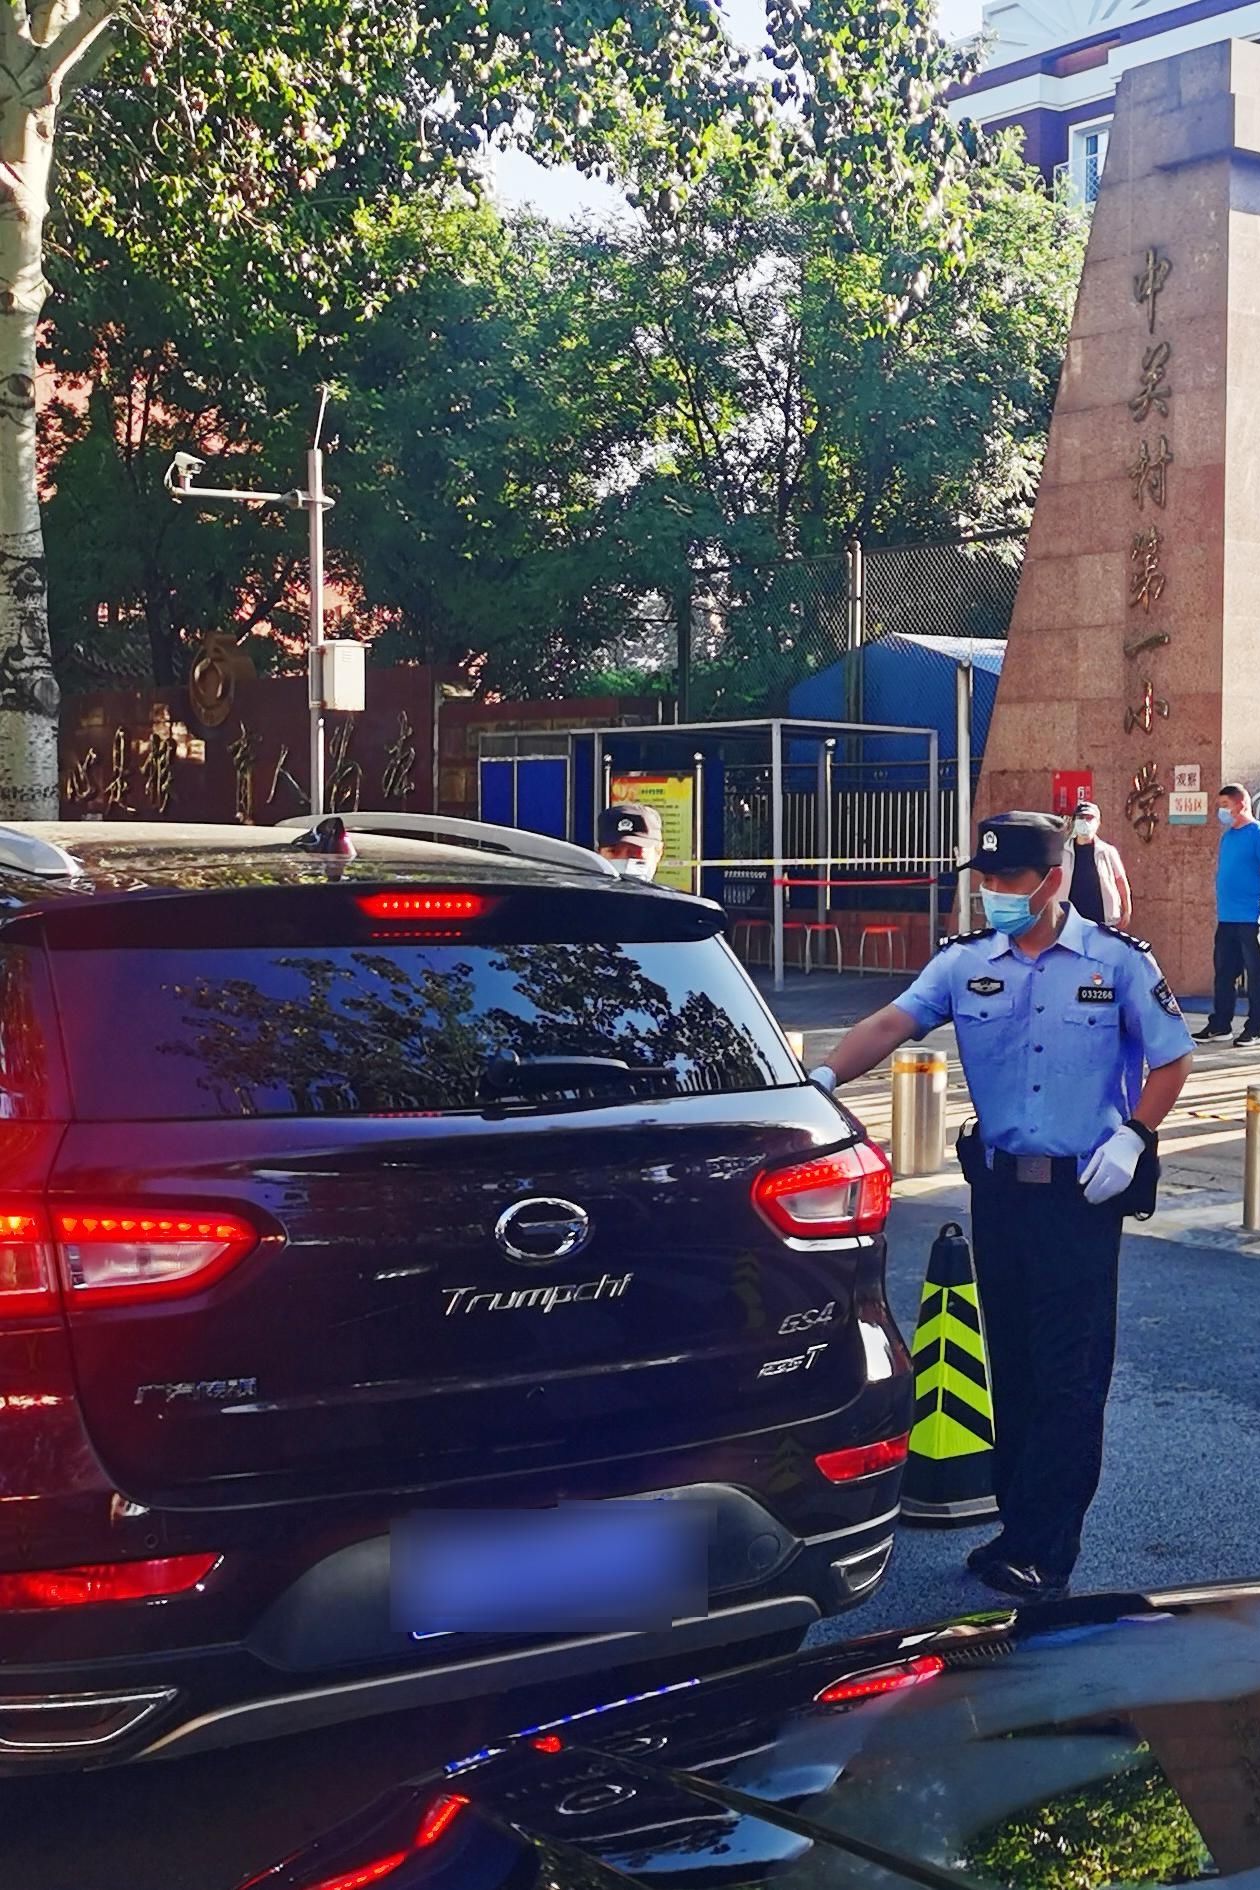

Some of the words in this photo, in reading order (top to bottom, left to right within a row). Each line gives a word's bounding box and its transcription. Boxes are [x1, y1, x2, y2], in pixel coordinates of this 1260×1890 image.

[1124, 246, 1174, 844] 中关村第一小学
[441, 1272, 635, 1316] Trumpchi
[777, 1301, 837, 1335] GS4
